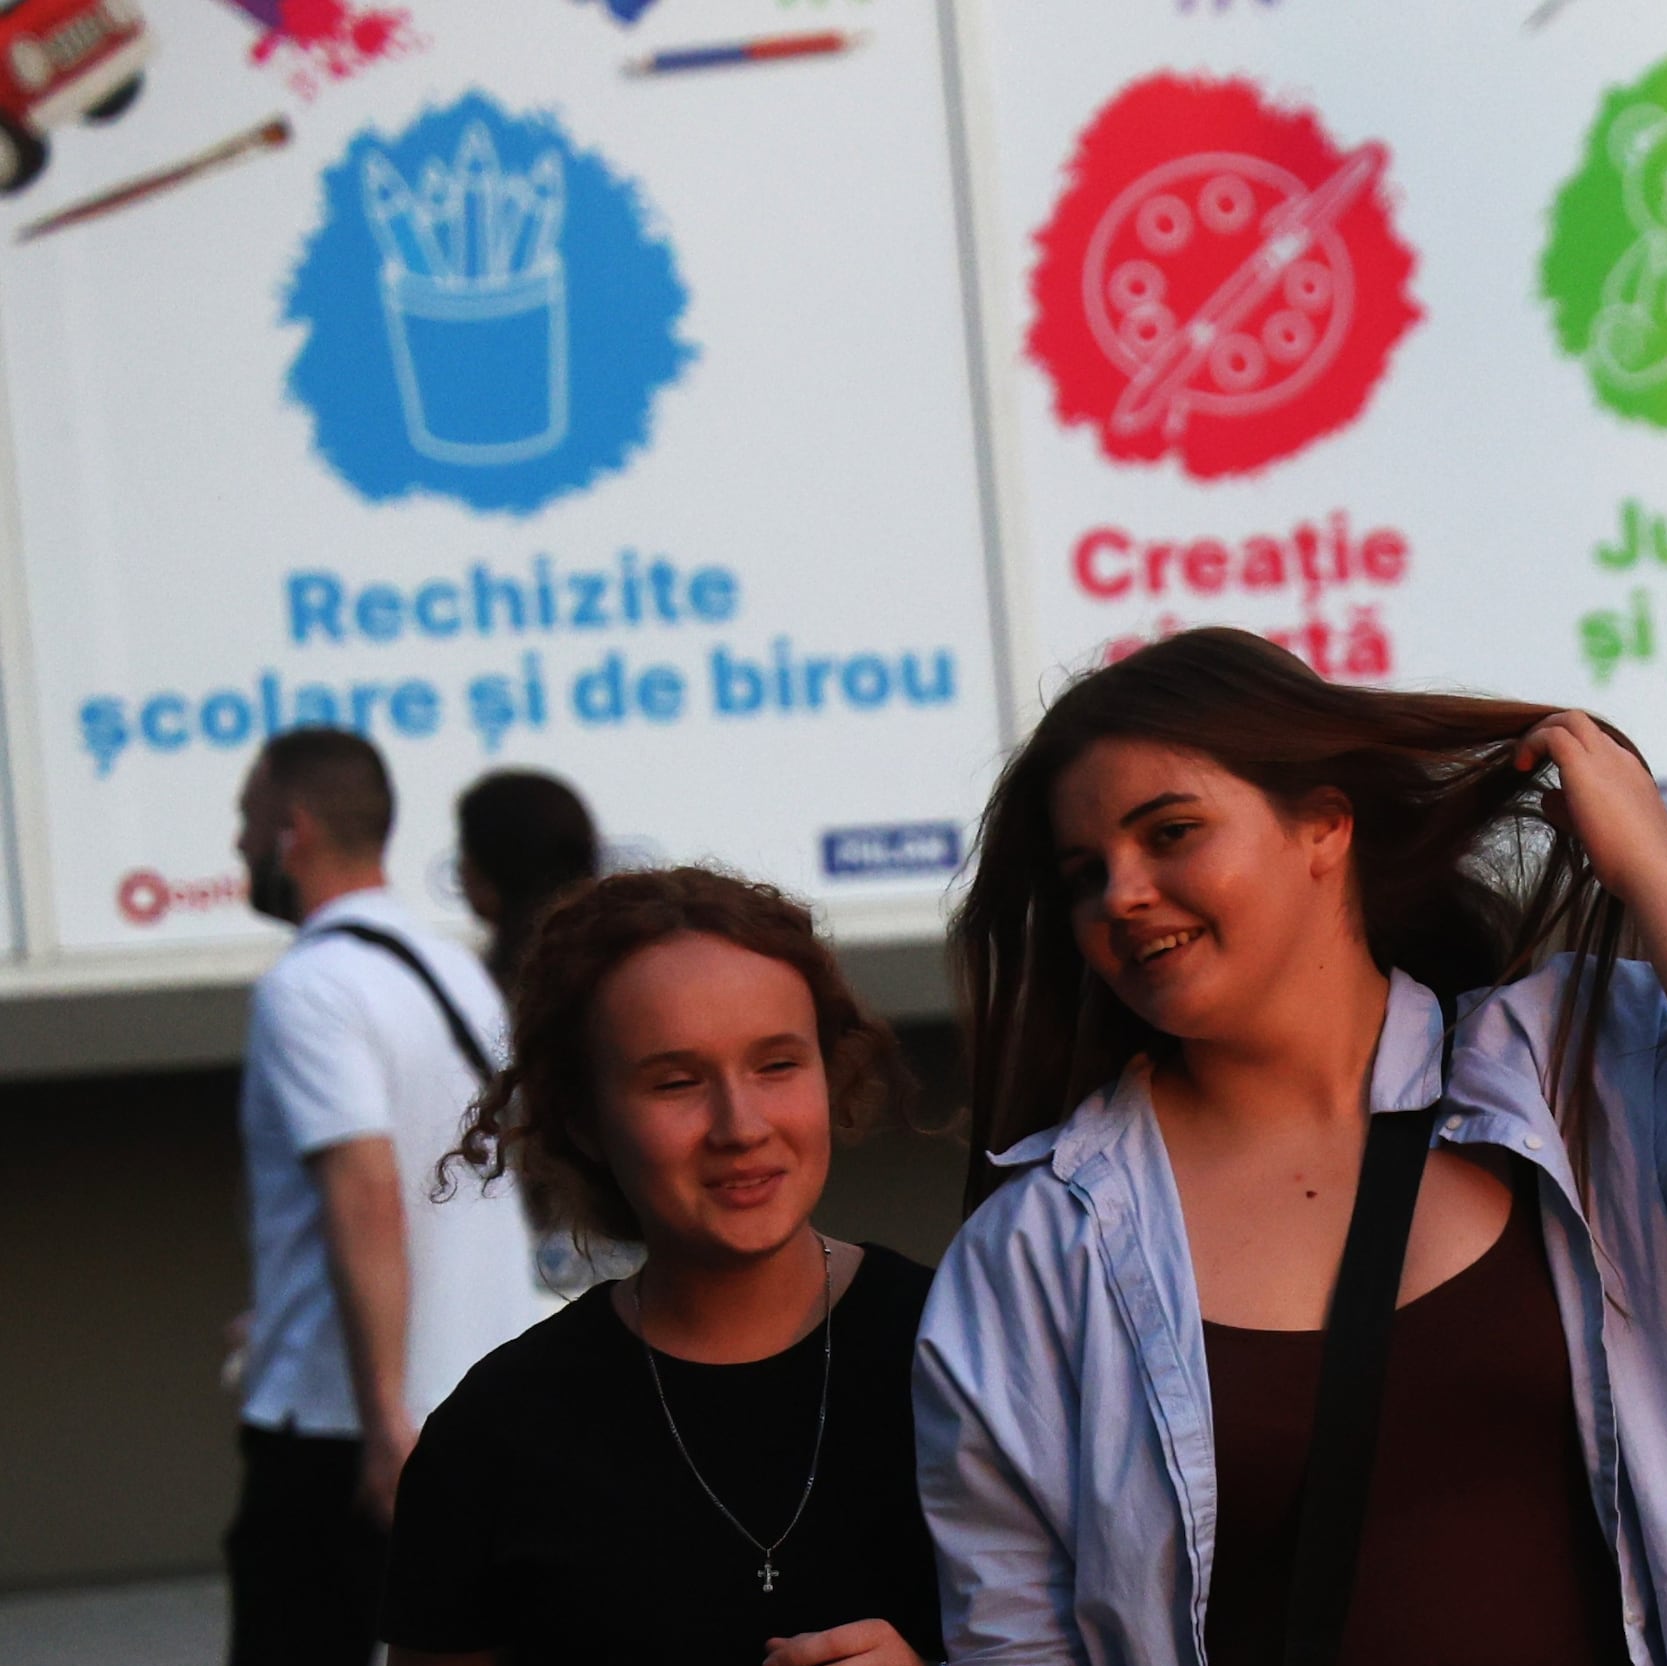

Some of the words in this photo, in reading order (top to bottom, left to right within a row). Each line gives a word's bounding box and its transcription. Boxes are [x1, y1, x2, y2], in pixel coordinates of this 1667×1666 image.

[286, 551, 739, 646] Rechizite
[1073, 511, 1409, 610] Creație
[1577, 597, 1654, 685] și
[79, 672, 442, 776] școlare
[468, 653, 548, 750] și
[571, 652, 687, 725] de
[709, 637, 957, 717] birou
